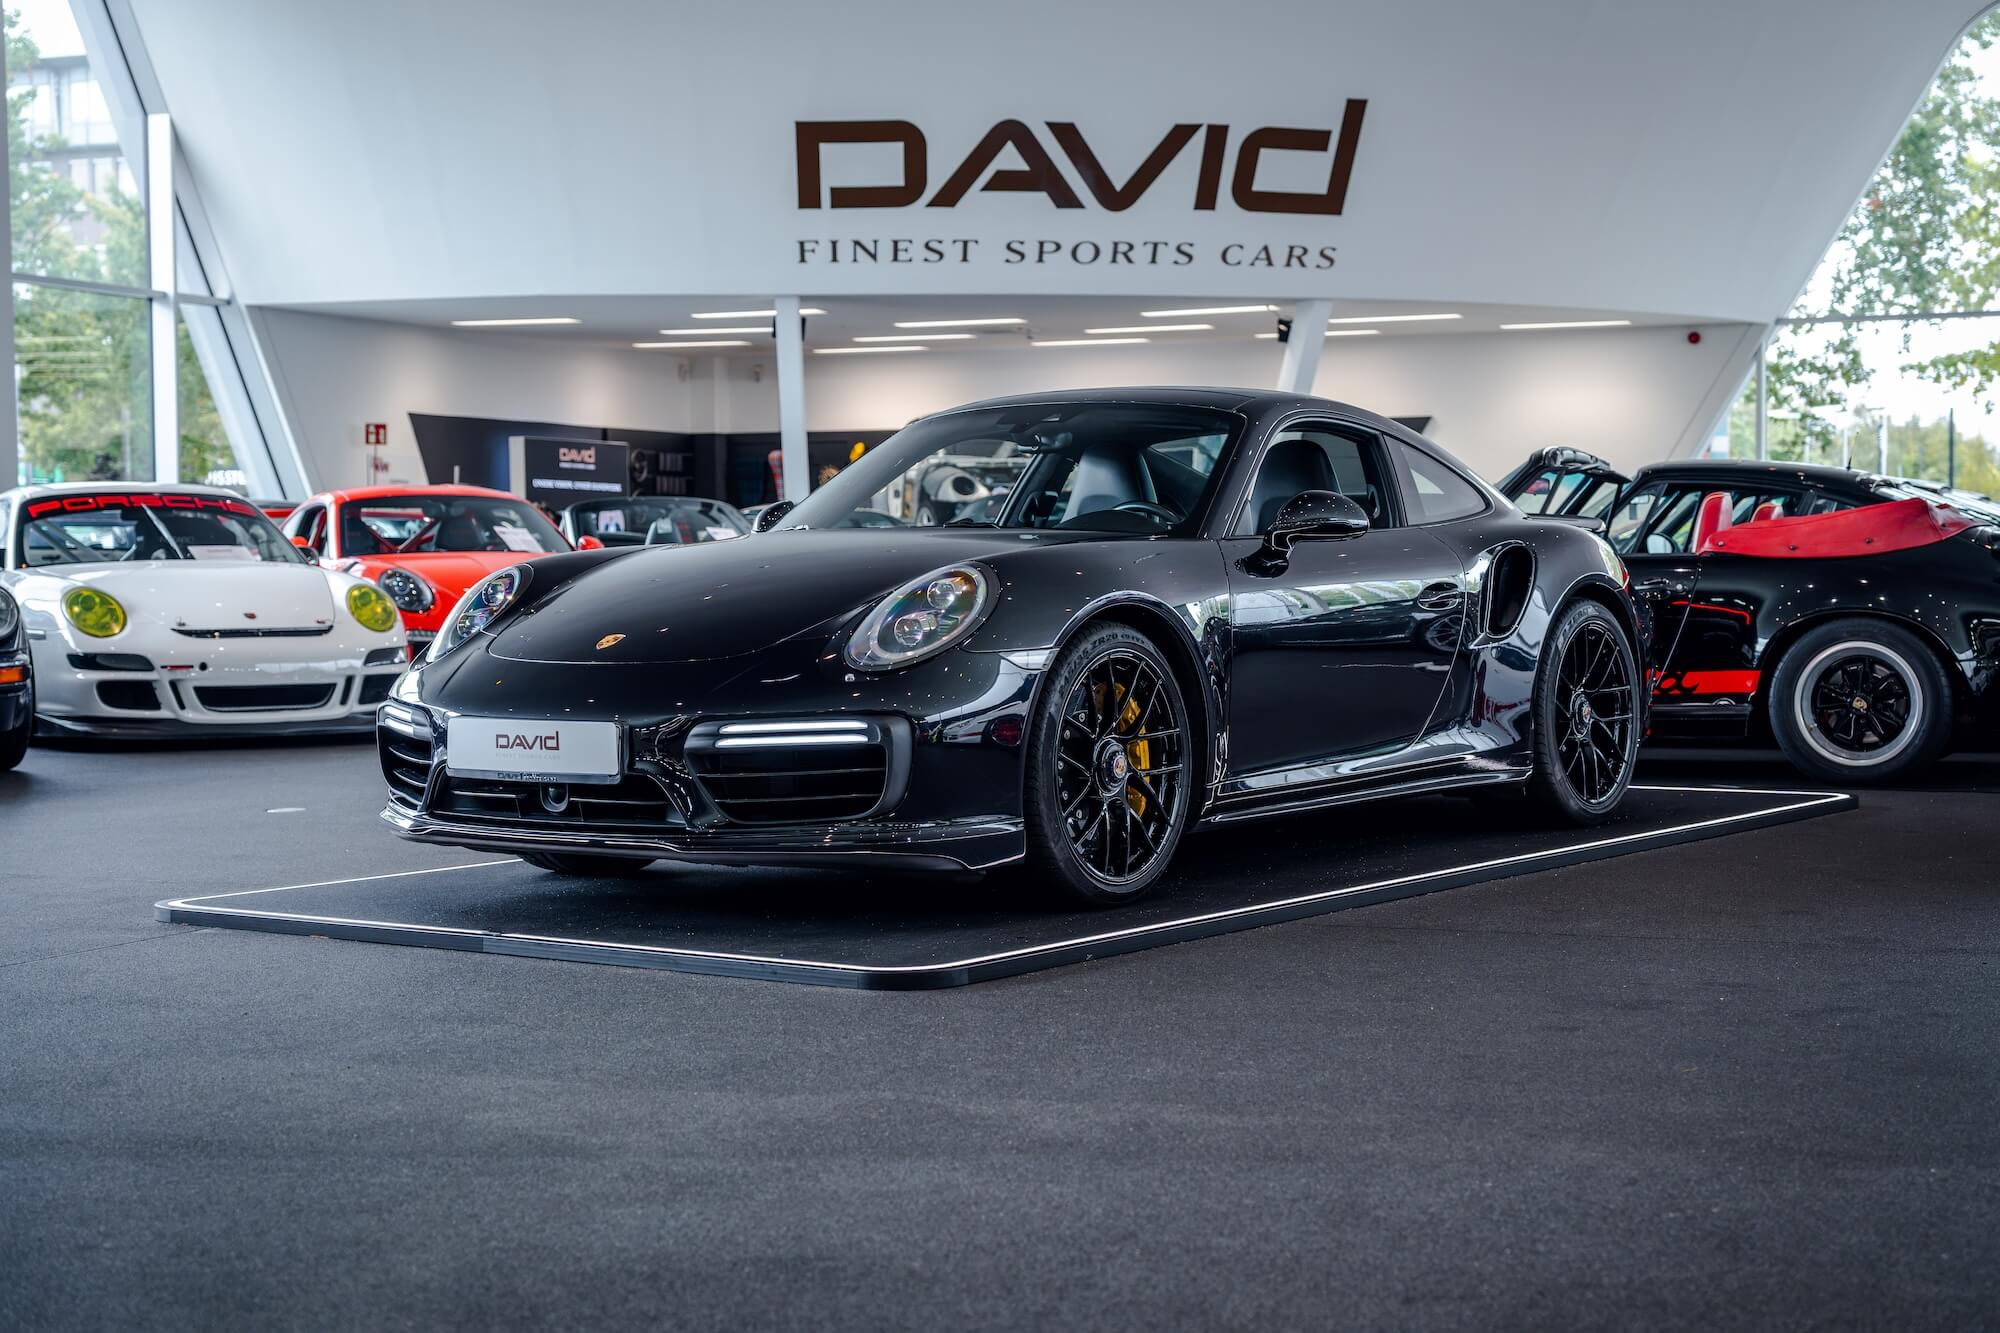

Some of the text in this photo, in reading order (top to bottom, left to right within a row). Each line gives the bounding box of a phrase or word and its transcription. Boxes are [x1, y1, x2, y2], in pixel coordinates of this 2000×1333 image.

[797, 239, 1337, 269] FINEST SPORTS CARS
[27, 495, 257, 518] PORSCHE
[1091, 633, 1118, 648] ZR20
